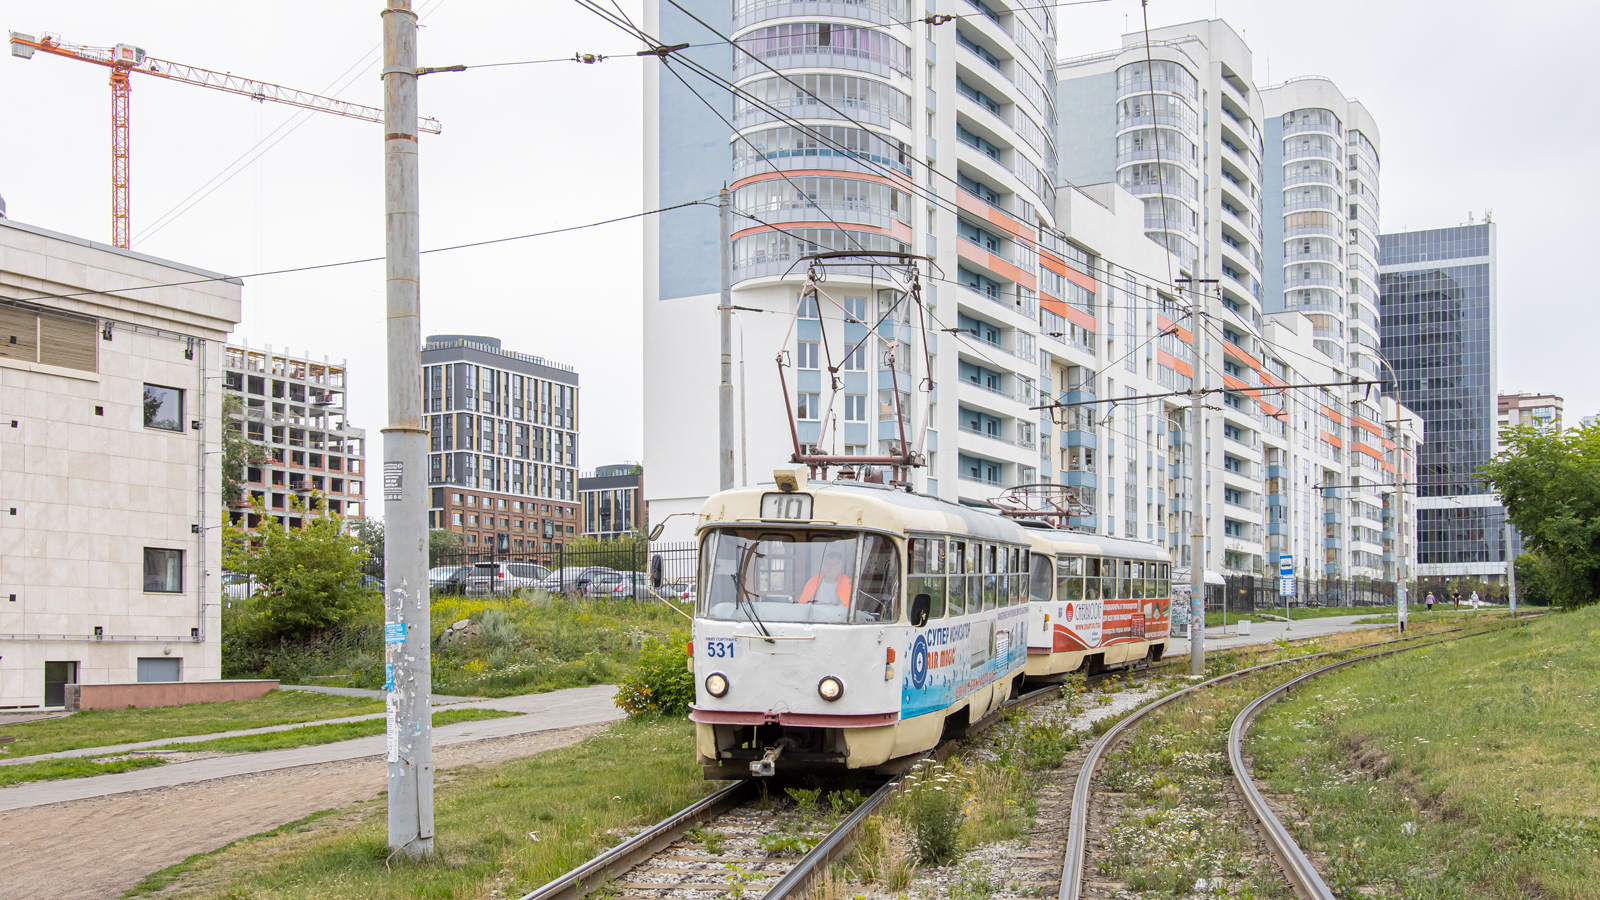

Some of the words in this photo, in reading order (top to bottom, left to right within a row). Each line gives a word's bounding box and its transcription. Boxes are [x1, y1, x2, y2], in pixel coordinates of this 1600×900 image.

[774, 495, 803, 519] 10
[927, 627, 950, 647] СУПЕР
[707, 641, 734, 658] 531
[926, 651, 939, 670] AIR
[940, 647, 956, 668] MAGIC
